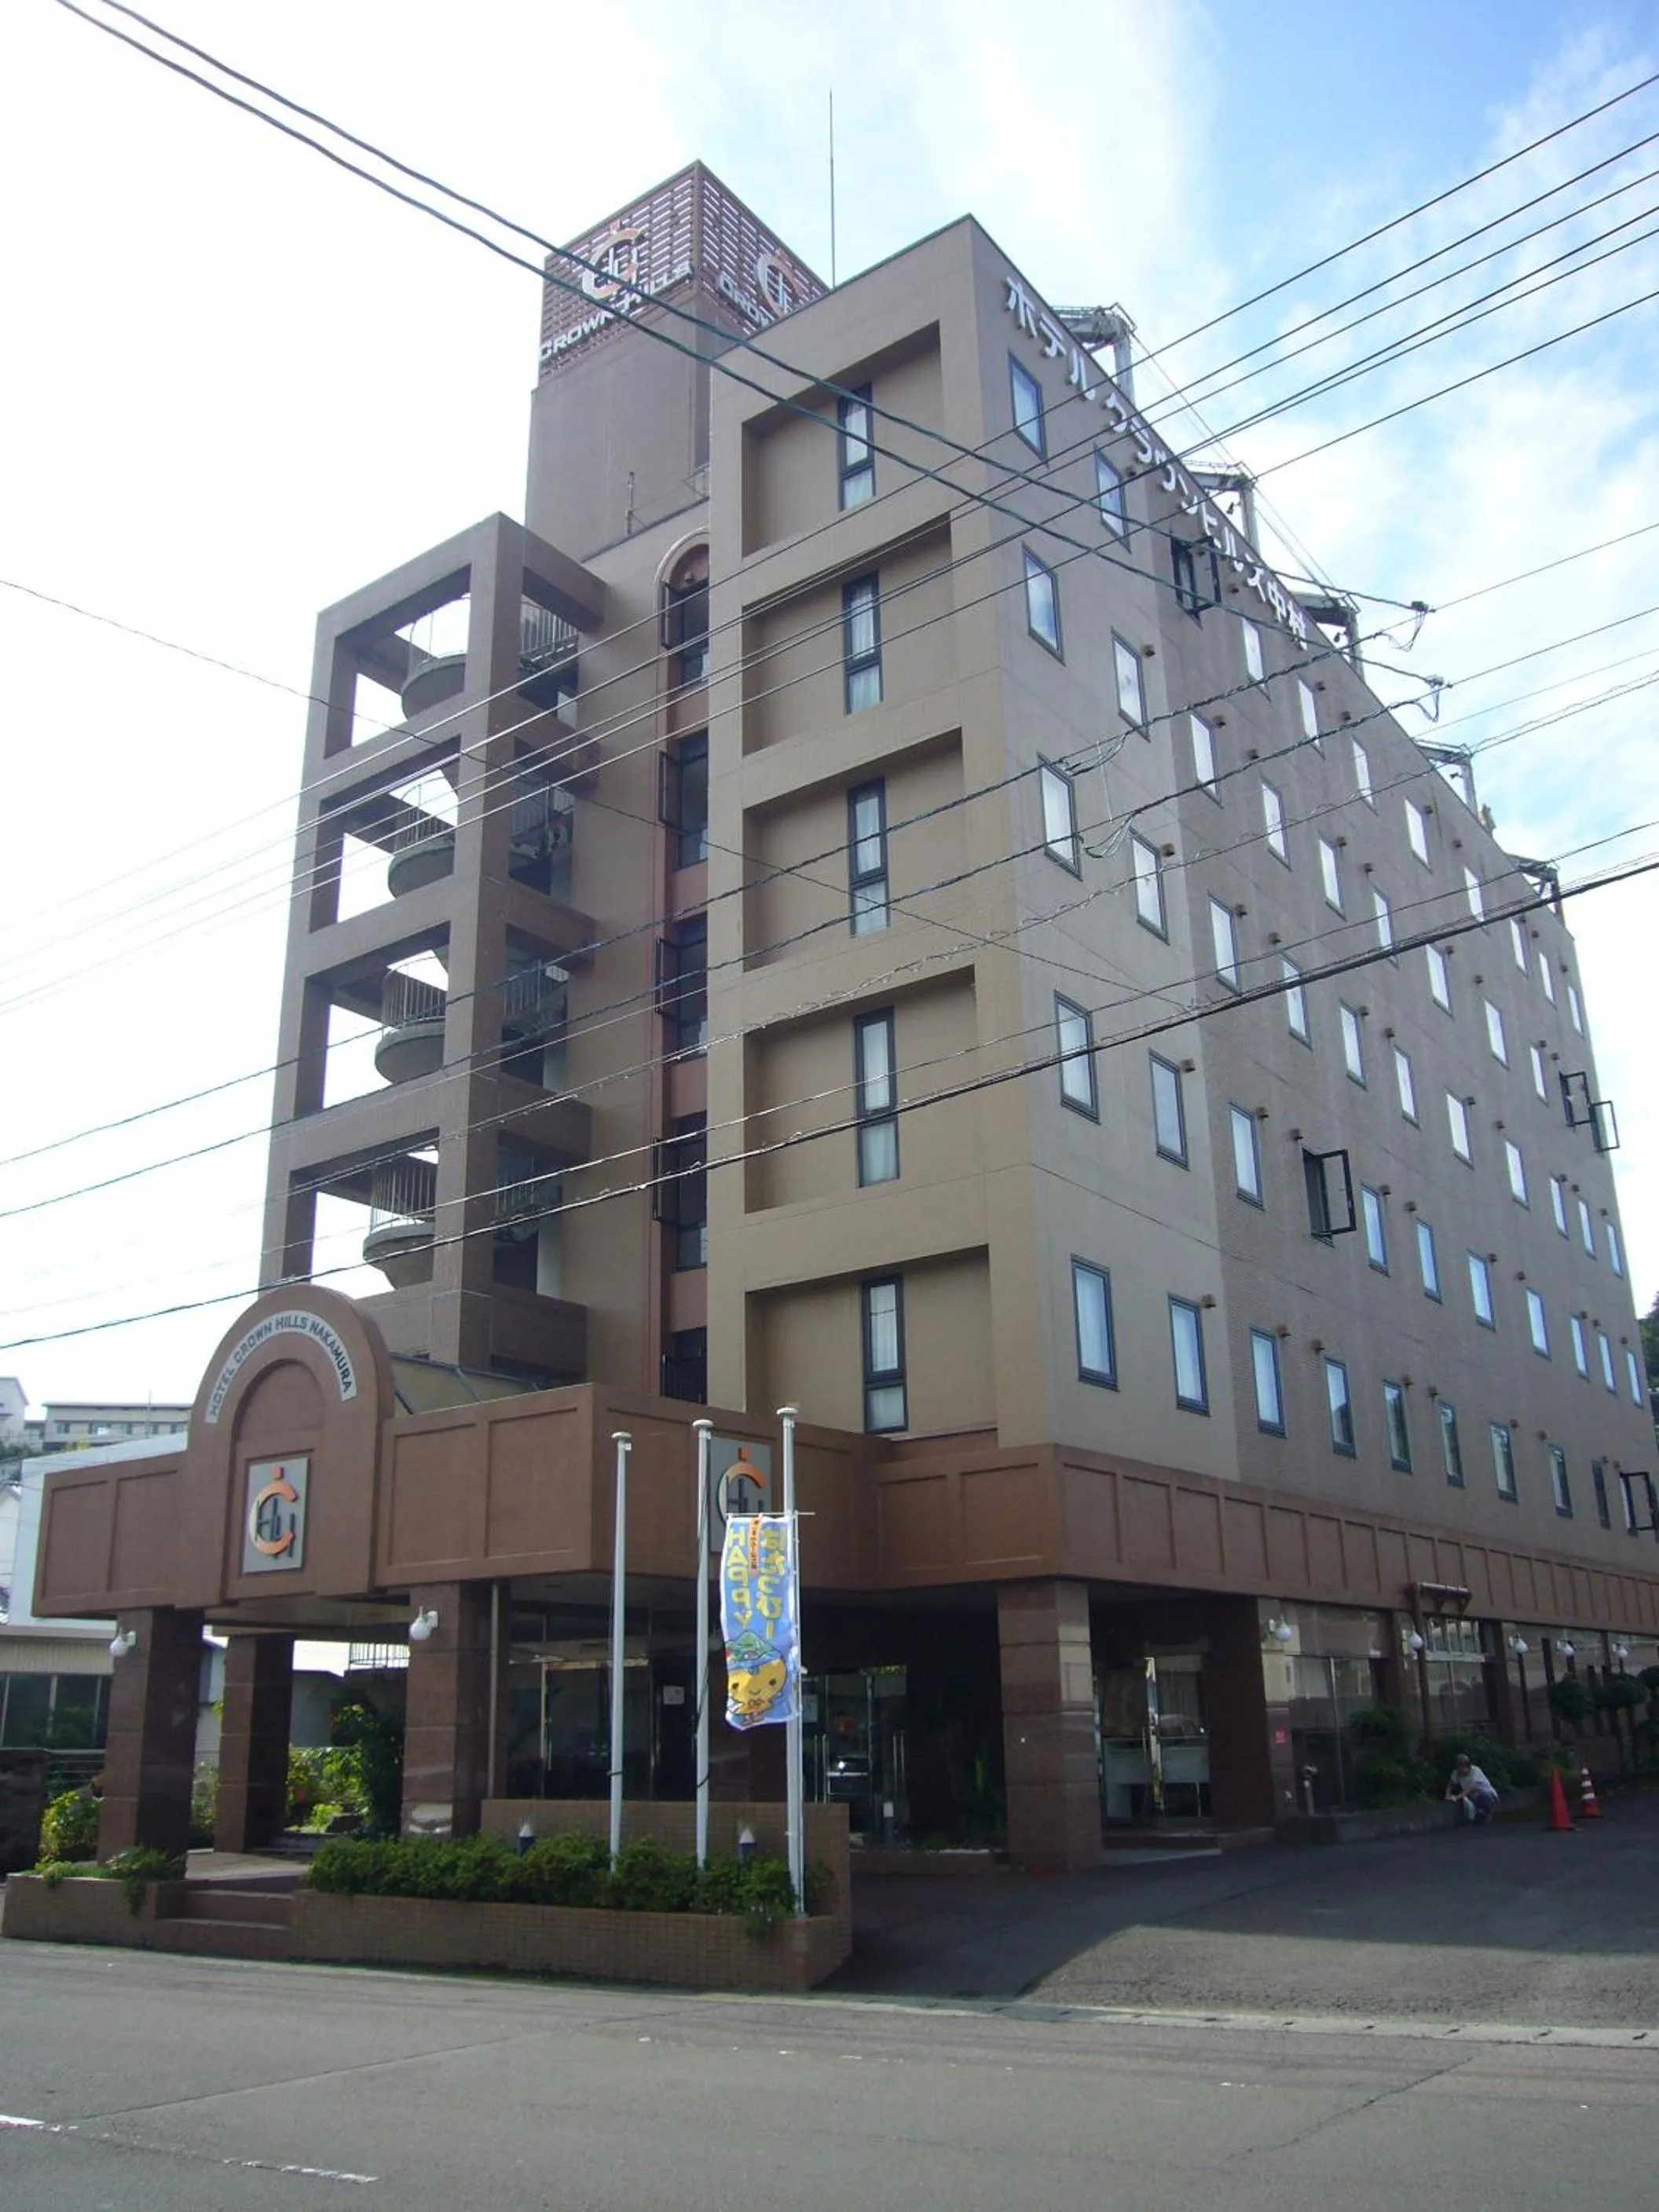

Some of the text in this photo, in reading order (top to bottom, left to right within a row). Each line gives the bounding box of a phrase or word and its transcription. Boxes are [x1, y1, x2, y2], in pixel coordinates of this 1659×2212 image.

[211, 1315, 353, 1416] HOTEL CROWN HILLS NAKAMURA
